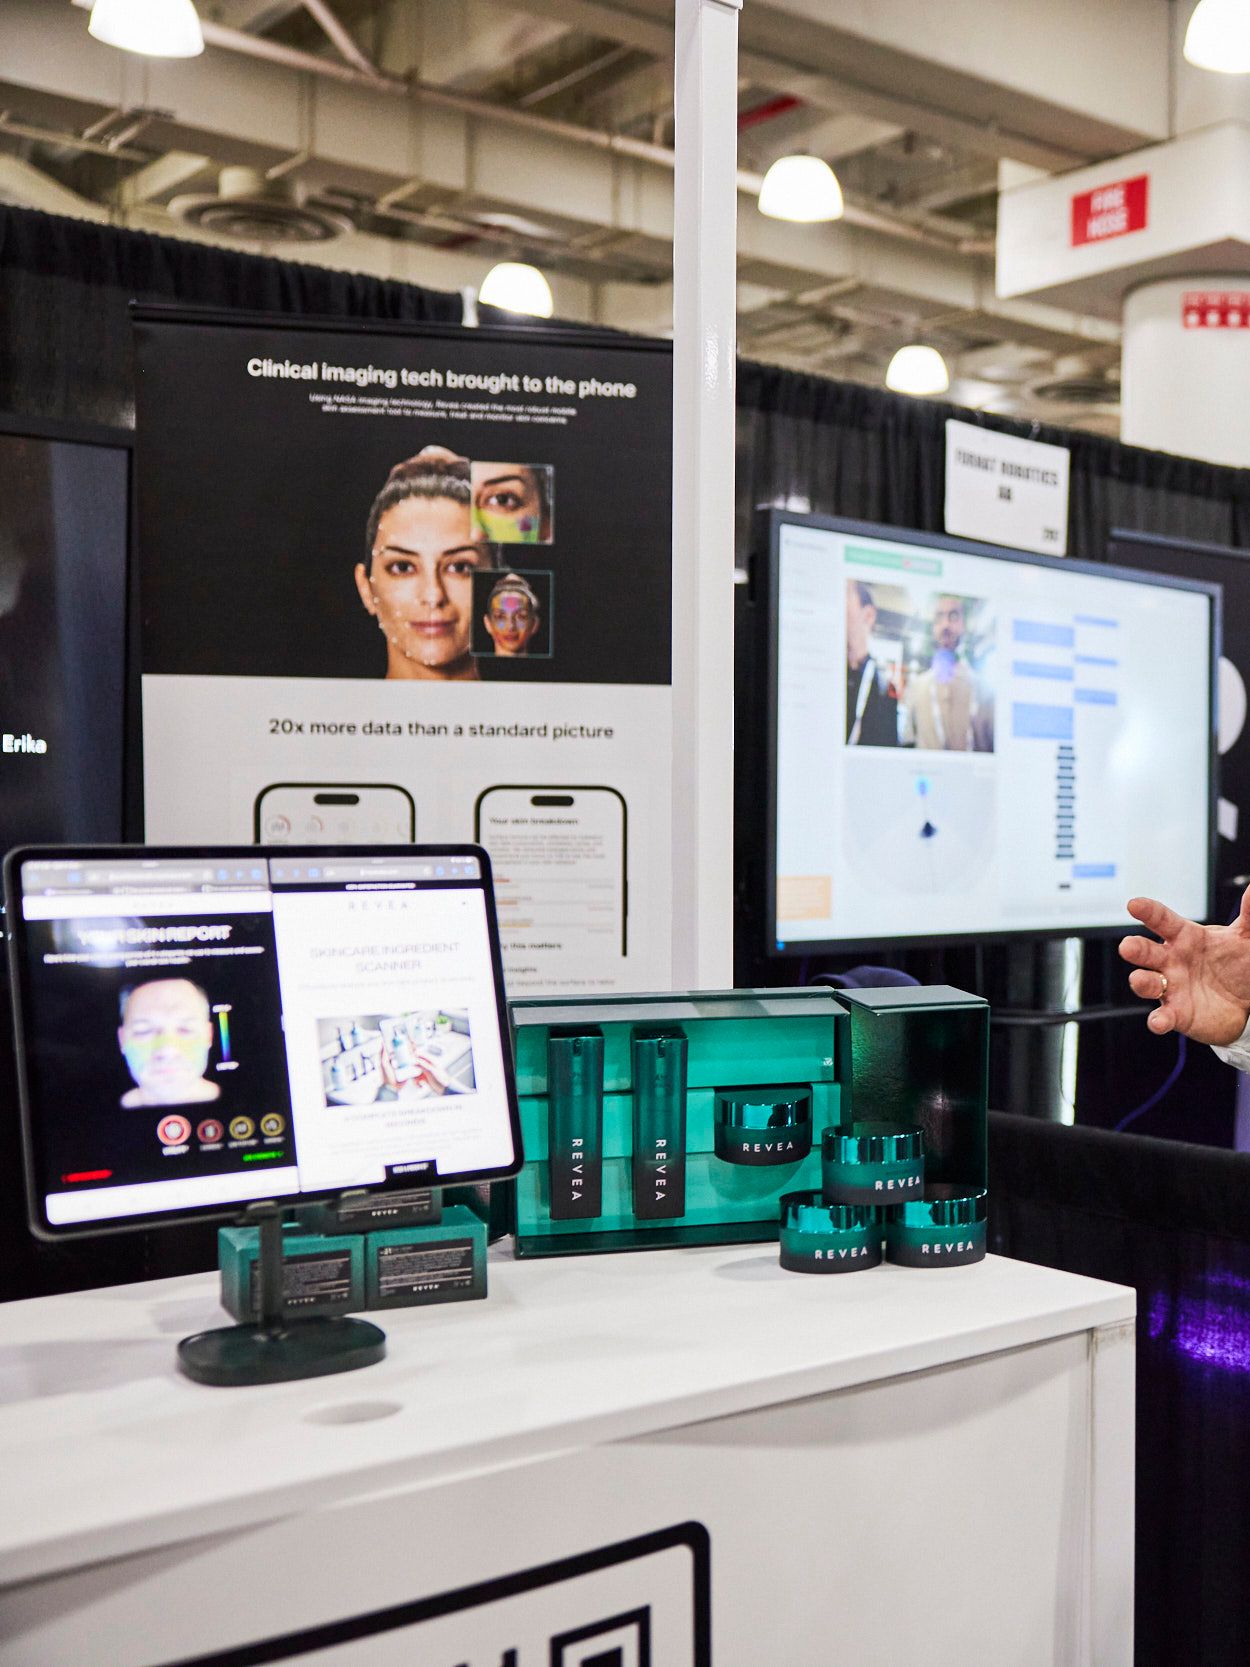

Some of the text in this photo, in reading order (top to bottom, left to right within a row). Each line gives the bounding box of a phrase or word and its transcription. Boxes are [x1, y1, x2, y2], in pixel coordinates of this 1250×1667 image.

[247, 358, 637, 399] Clinical imaging tech brought to the phone
[268, 718, 614, 741] 20x more data than a standard picture
[2, 733, 47, 754] Erika
[167, 924, 232, 943] REPORT
[310, 942, 460, 959] SKINCARE INGREDIENT
[356, 960, 422, 973] SCANNER
[742, 1141, 794, 1152] REVEA
[571, 1139, 583, 1201] REVEA
[655, 1139, 667, 1201] REVEA
[875, 1175, 921, 1191] REVEA
[814, 1246, 868, 1260] REVEA
[921, 1240, 974, 1254] REVEA
